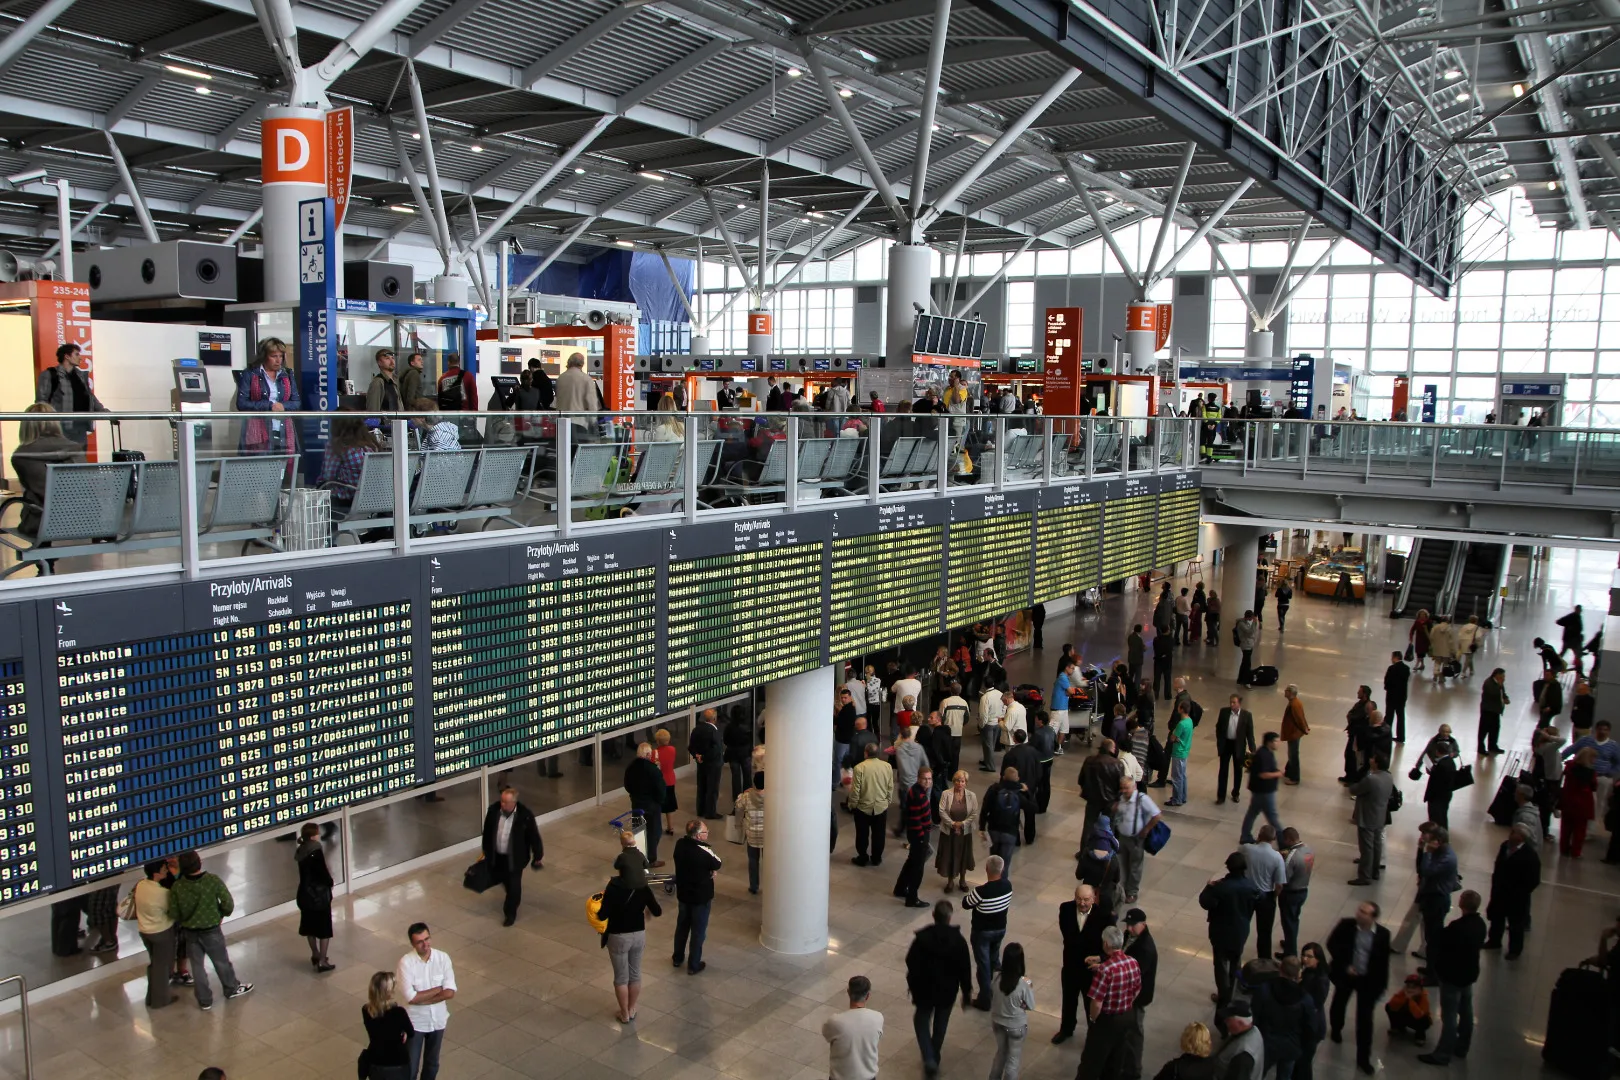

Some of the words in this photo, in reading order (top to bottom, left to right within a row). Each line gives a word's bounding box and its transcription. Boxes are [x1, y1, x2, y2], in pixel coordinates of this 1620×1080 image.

[336, 112, 344, 173] check-in
[277, 128, 310, 172] D
[337, 178, 345, 205] Self
[53, 286, 90, 296] 235-244
[755, 318, 766, 332] E
[1141, 310, 1152, 327] E
[316, 309, 328, 440] Inormation
[734, 519, 771, 532] Przyloty/Arrivals
[527, 541, 580, 558] Przyloty/Arrivals
[210, 574, 292, 598] Przyloty/Arrivals
[562, 577, 583, 588] 09:55
[306, 590, 326, 600] Wyjście
[331, 586, 346, 596] Uwagi
[561, 591, 583, 602] 09:55
[268, 595, 288, 605] Rozkład
[332, 598, 353, 608] Remarks
[212, 604, 232, 612] Numer
[233, 602, 248, 610] rejsu
[268, 607, 292, 618] Schedule
[306, 604, 316, 612] Exit
[562, 604, 582, 616] 09:55
[214, 617, 230, 626] Flight
[230, 615, 240, 623] No.
[562, 618, 583, 630] 09:55
[57, 647, 131, 667] Sztokholm
[213, 630, 227, 642] LO
[234, 626, 254, 638] 456
[268, 620, 300, 634] 09:40
[383, 603, 410, 616] 09:47
[562, 632, 583, 644] 09:55
[58, 639, 76, 648] From
[58, 667, 124, 687] Bruksela
[214, 648, 228, 660] LO
[235, 644, 255, 657] 232
[268, 637, 301, 651] 09:50
[383, 619, 411, 632] 09:40
[562, 645, 583, 657] 09:55
[60, 686, 125, 706] Bruksela
[215, 666, 229, 678] SN
[236, 660, 263, 674] 5153
[269, 654, 301, 668] 09:50
[384, 634, 411, 648] 09:40
[562, 659, 583, 671] 09:55
[563, 672, 583, 684] 10:00
[61, 706, 126, 726] Katowice
[216, 684, 230, 696] LO
[270, 671, 302, 686] 09:50
[384, 650, 410, 664] 09:51
[563, 686, 583, 698] 10:00
[62, 725, 128, 745] Mediolan
[217, 702, 230, 714] LO
[237, 696, 258, 710] 322
[271, 687, 303, 703] 09:50
[385, 666, 412, 679] 09:34
[563, 699, 583, 712] 10:00
[64, 745, 121, 765] Chicago
[218, 720, 232, 731] LO
[238, 714, 258, 727] 002
[272, 704, 303, 720] 09:50
[386, 681, 412, 695] 10:00
[563, 712, 583, 725] 10:05
[563, 726, 583, 739] 10:05
[65, 764, 122, 784] Chicago
[219, 737, 232, 749] UA
[239, 730, 266, 744] 9436
[272, 721, 304, 737] 09:50
[386, 697, 413, 711] 10:00
[66, 783, 116, 803] Wiedeń
[273, 738, 305, 754] 09:50
[382, 713, 408, 728] 11:10
[68, 801, 117, 822] Wiedeń
[221, 772, 234, 784] LO
[241, 764, 267, 779] 5222
[274, 754, 306, 770] 09:50
[382, 729, 408, 743] 11:10
[222, 789, 235, 801] LO
[275, 770, 306, 787] 09:50
[387, 743, 414, 758] 09:52
[222, 806, 236, 818] AC
[275, 787, 307, 804] 09:50
[388, 758, 414, 773] 09:52
[276, 803, 308, 821] 09:50
[388, 773, 415, 789] 09:52
